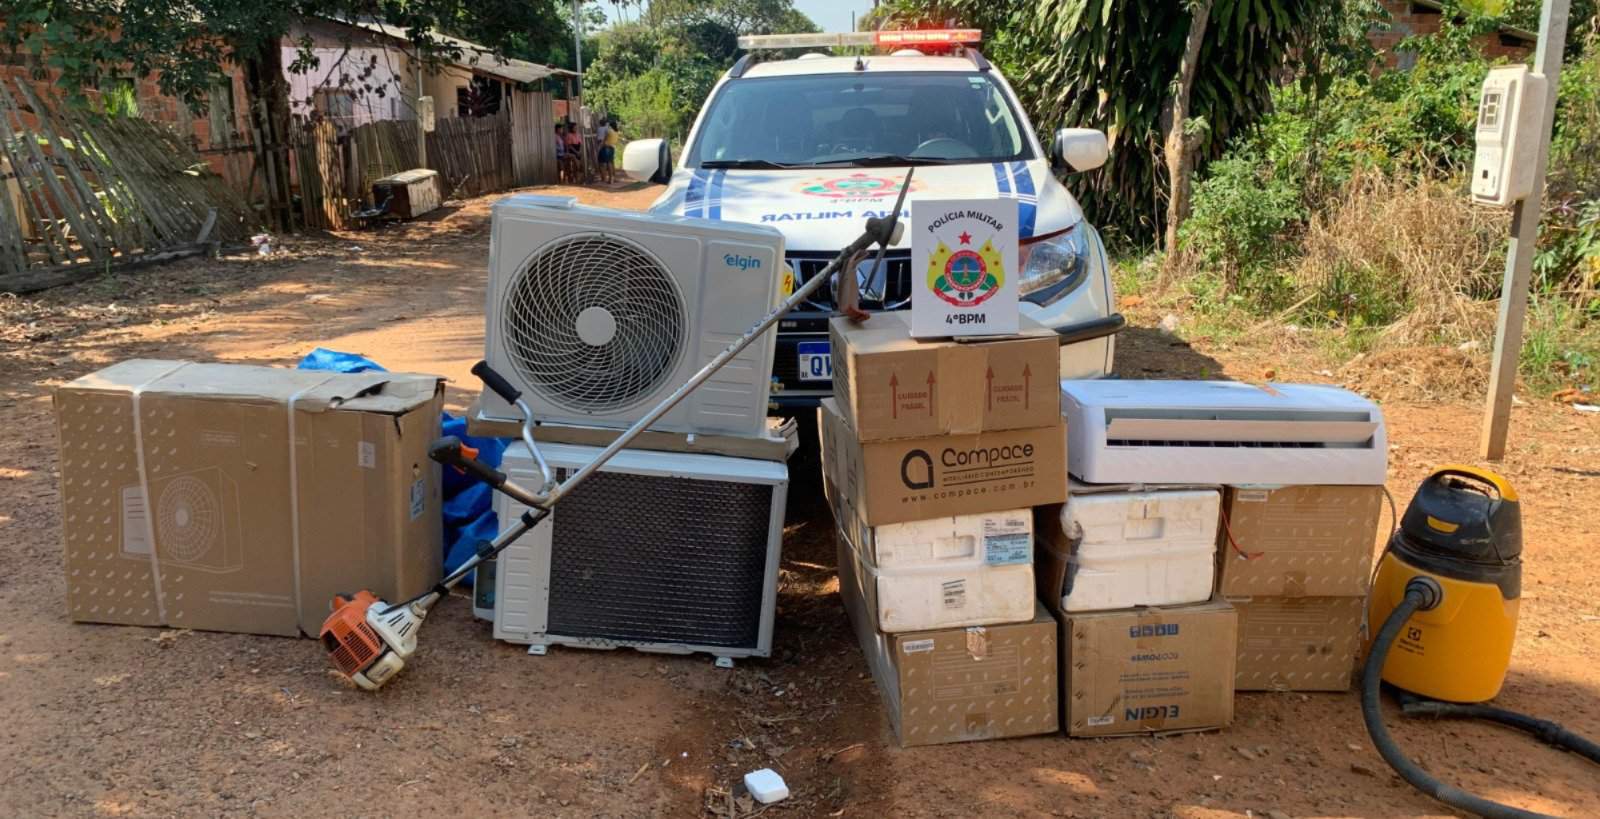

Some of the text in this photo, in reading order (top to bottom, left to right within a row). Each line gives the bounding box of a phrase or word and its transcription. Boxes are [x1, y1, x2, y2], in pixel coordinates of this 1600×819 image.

[928, 210, 1004, 233] POLÍCIA MILITAR
[724, 254, 761, 270] elgin
[941, 443, 1034, 467] Compace
[1125, 705, 1179, 721] ELGIN
